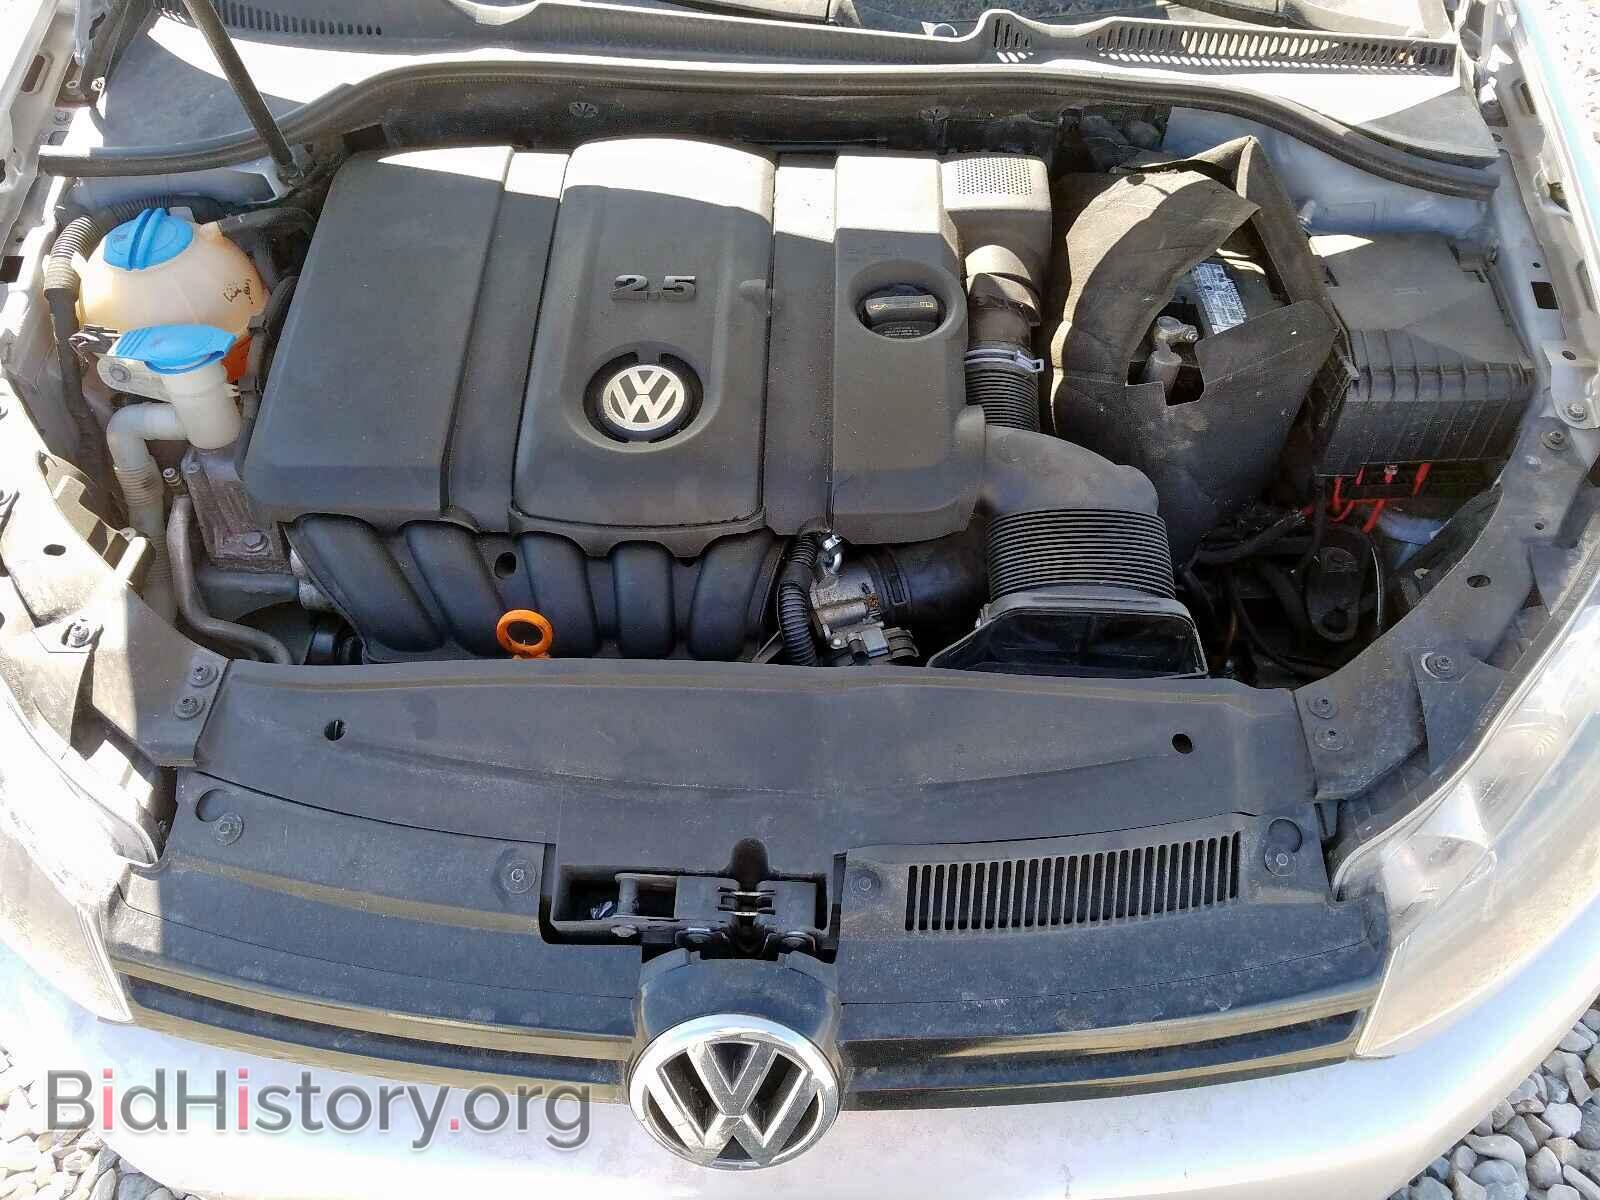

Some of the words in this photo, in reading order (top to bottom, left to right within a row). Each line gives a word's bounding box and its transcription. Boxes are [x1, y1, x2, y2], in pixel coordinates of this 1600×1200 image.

[611, 274, 697, 303] 2.5
[603, 365, 684, 431] VW
[630, 1016, 838, 1170] VW
